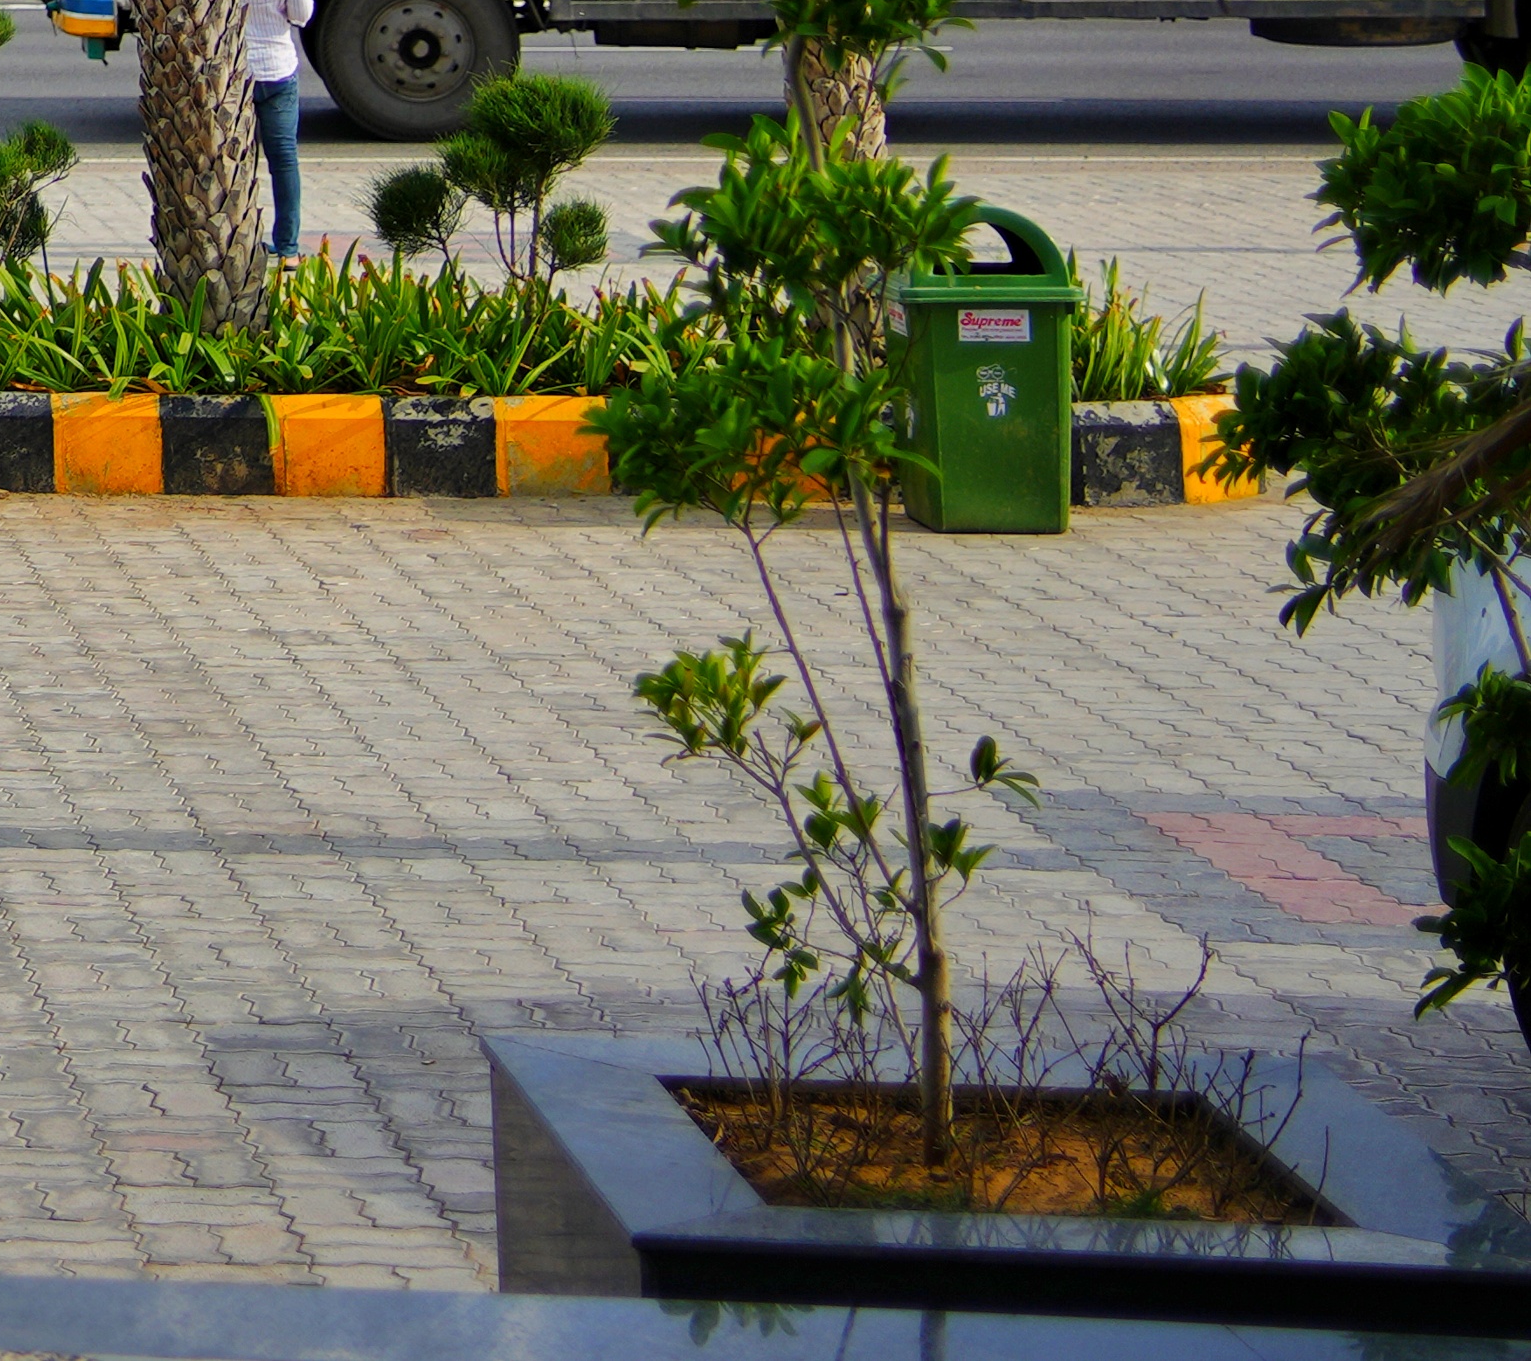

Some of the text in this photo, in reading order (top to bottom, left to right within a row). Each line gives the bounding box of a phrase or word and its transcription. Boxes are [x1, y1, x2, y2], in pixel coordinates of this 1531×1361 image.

[960, 312, 1022, 329] Supreme
[979, 383, 1016, 399] USE ME
